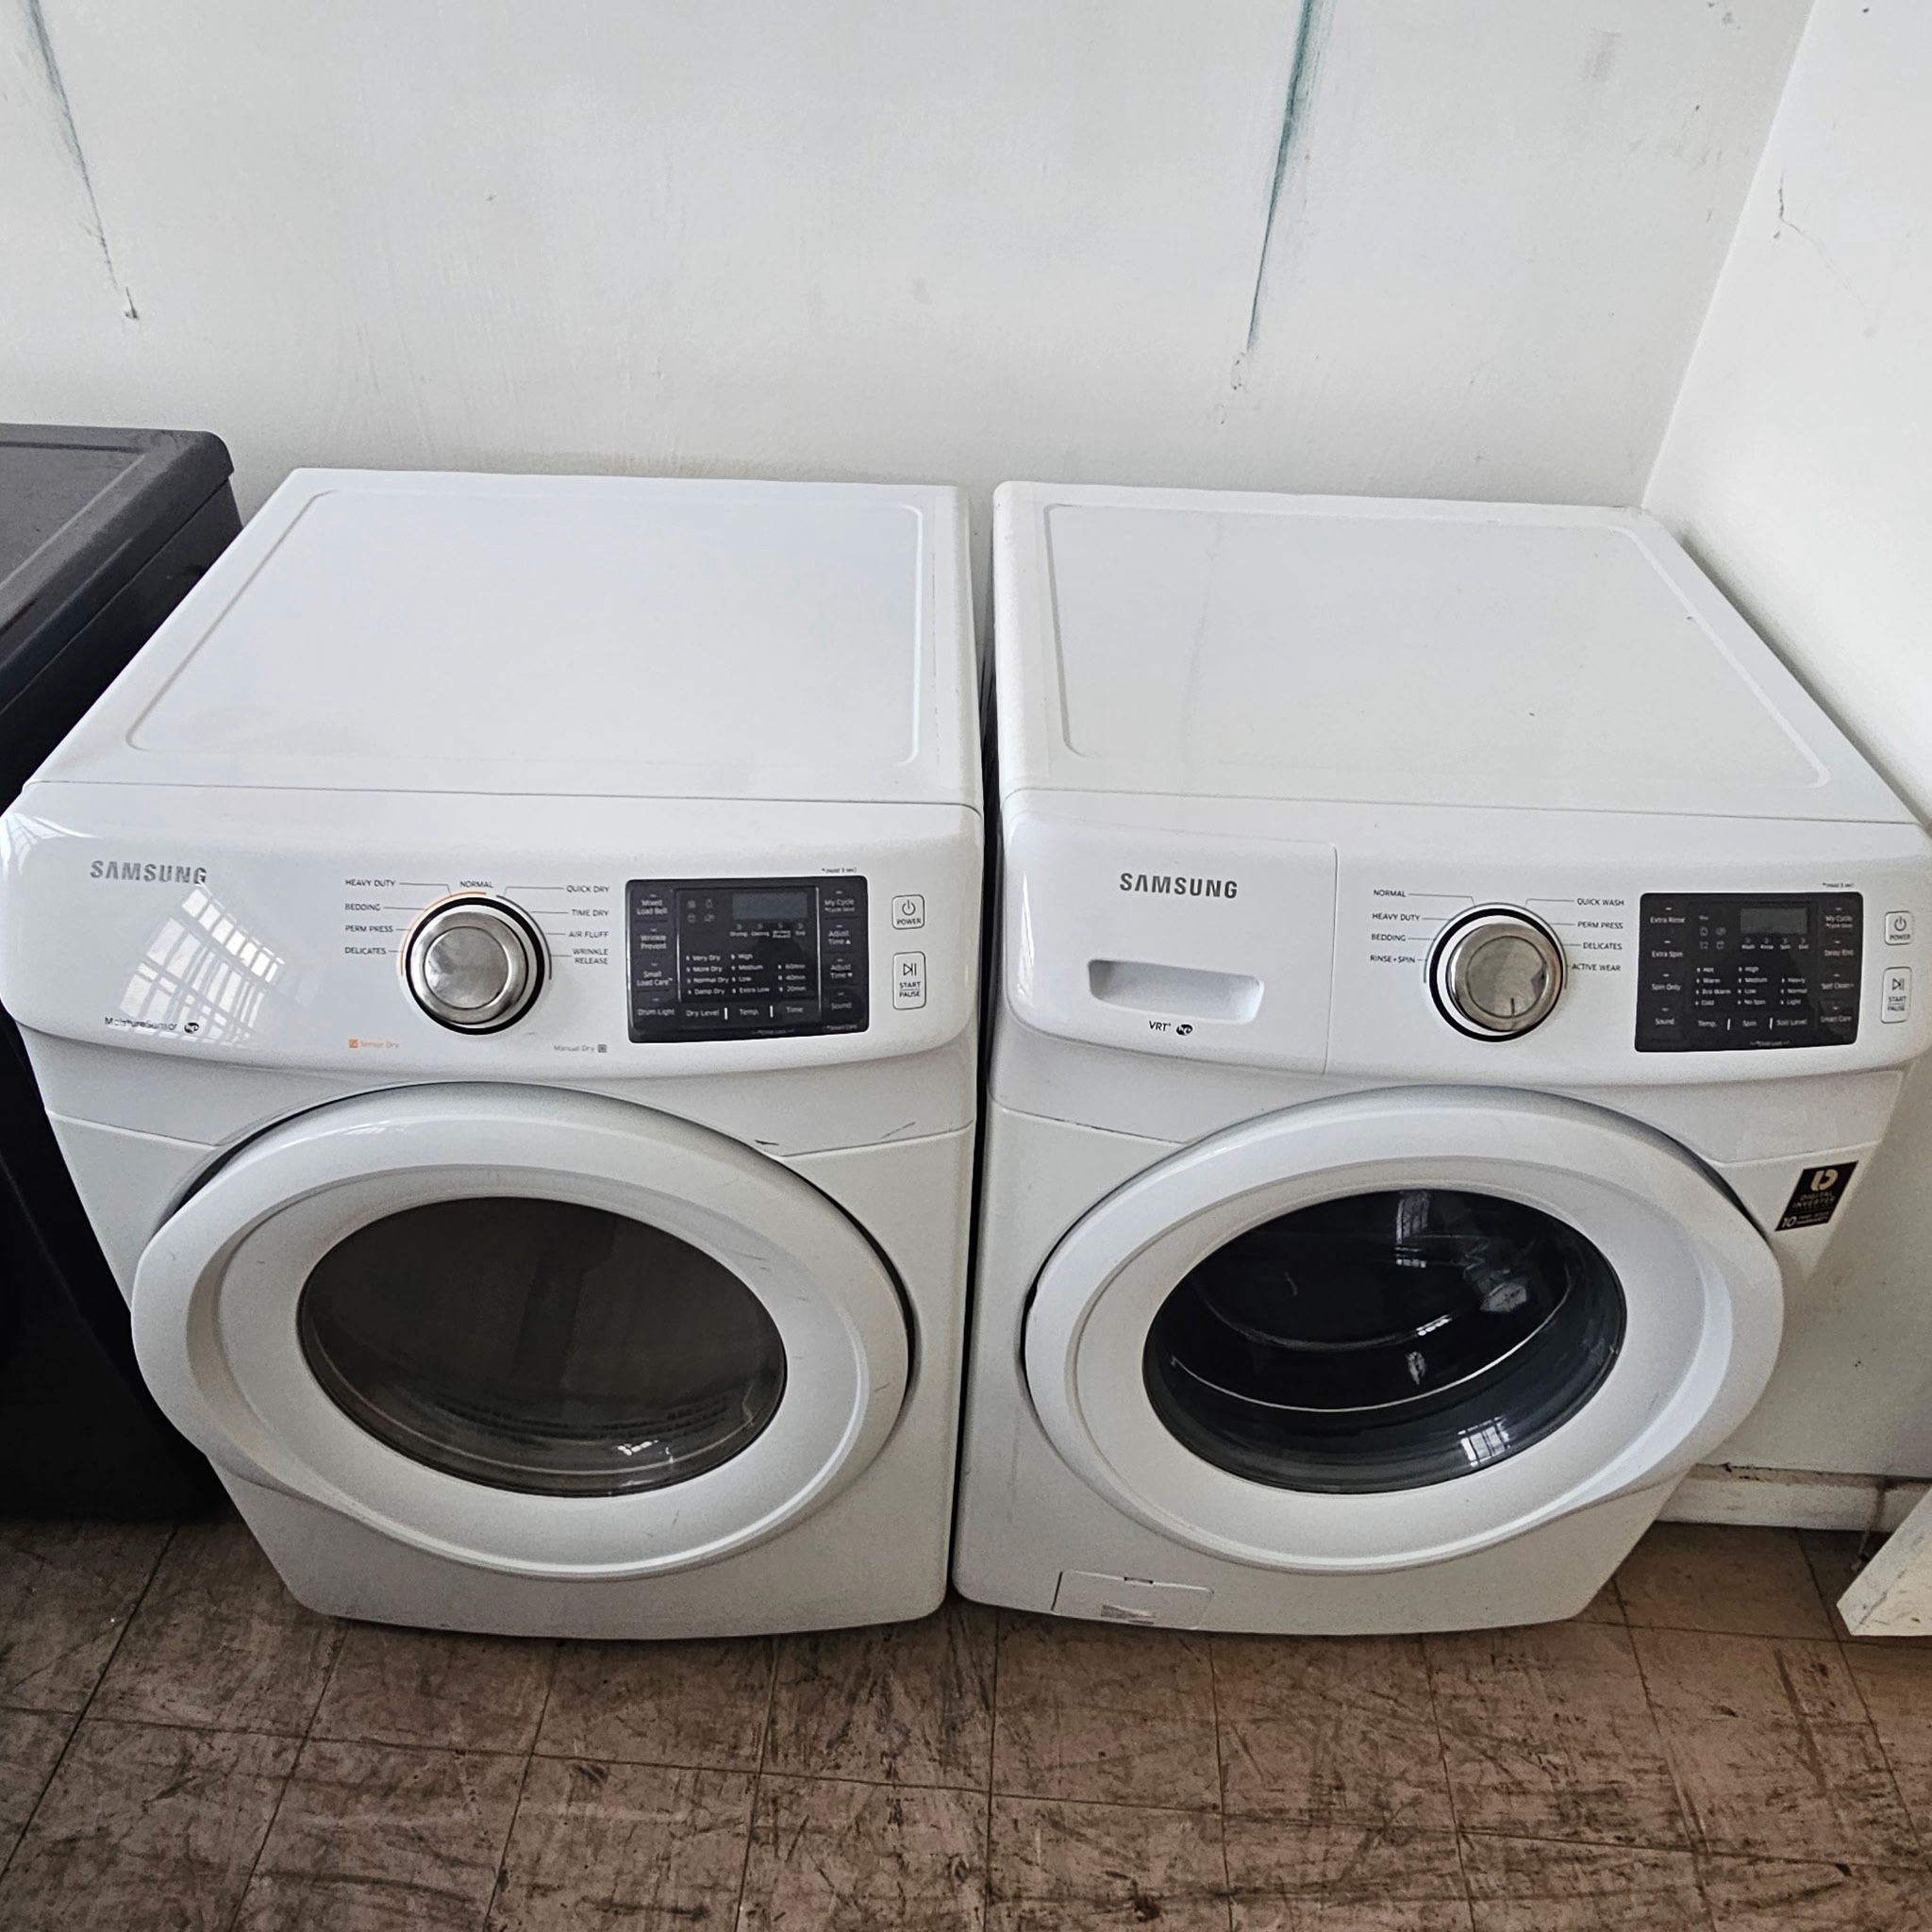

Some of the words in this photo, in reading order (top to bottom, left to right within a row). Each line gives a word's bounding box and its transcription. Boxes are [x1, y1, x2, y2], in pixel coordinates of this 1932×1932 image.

[90, 859, 208, 884] SAMSUNG
[344, 879, 372, 888] HEAVY
[374, 879, 395, 888] DUTY
[459, 880, 493, 889] NORMAL
[1119, 872, 1238, 899] SAMSUNG
[566, 885, 591, 893] QUICK
[592, 885, 609, 893] DRY
[824, 899, 835, 908] My
[836, 898, 855, 907] Cycle
[1577, 897, 1601, 906] QUICK
[1602, 898, 1624, 907] WASH
[572, 908, 591, 917] TIME
[592, 908, 609, 917] DRY
[1372, 912, 1398, 921] HEAVY
[1400, 913, 1421, 922] DUTY
[1577, 921, 1599, 929] PERM
[1601, 921, 1624, 929] PRESS
[568, 930, 582, 939] AIR
[584, 930, 609, 939] FLUFF
[828, 930, 849, 939] Adjust
[1890, 933, 1911, 941] POWER
[574, 957, 608, 965] RELEASE
[1572, 963, 1597, 972] ACTIVE
[1652, 983, 1666, 991] Spin
[1667, 983, 1681, 991] Only
[658, 1008, 675, 1017] Light
[686, 1009, 699, 1018] Dry
[1781, 1216, 1798, 1227] 10
